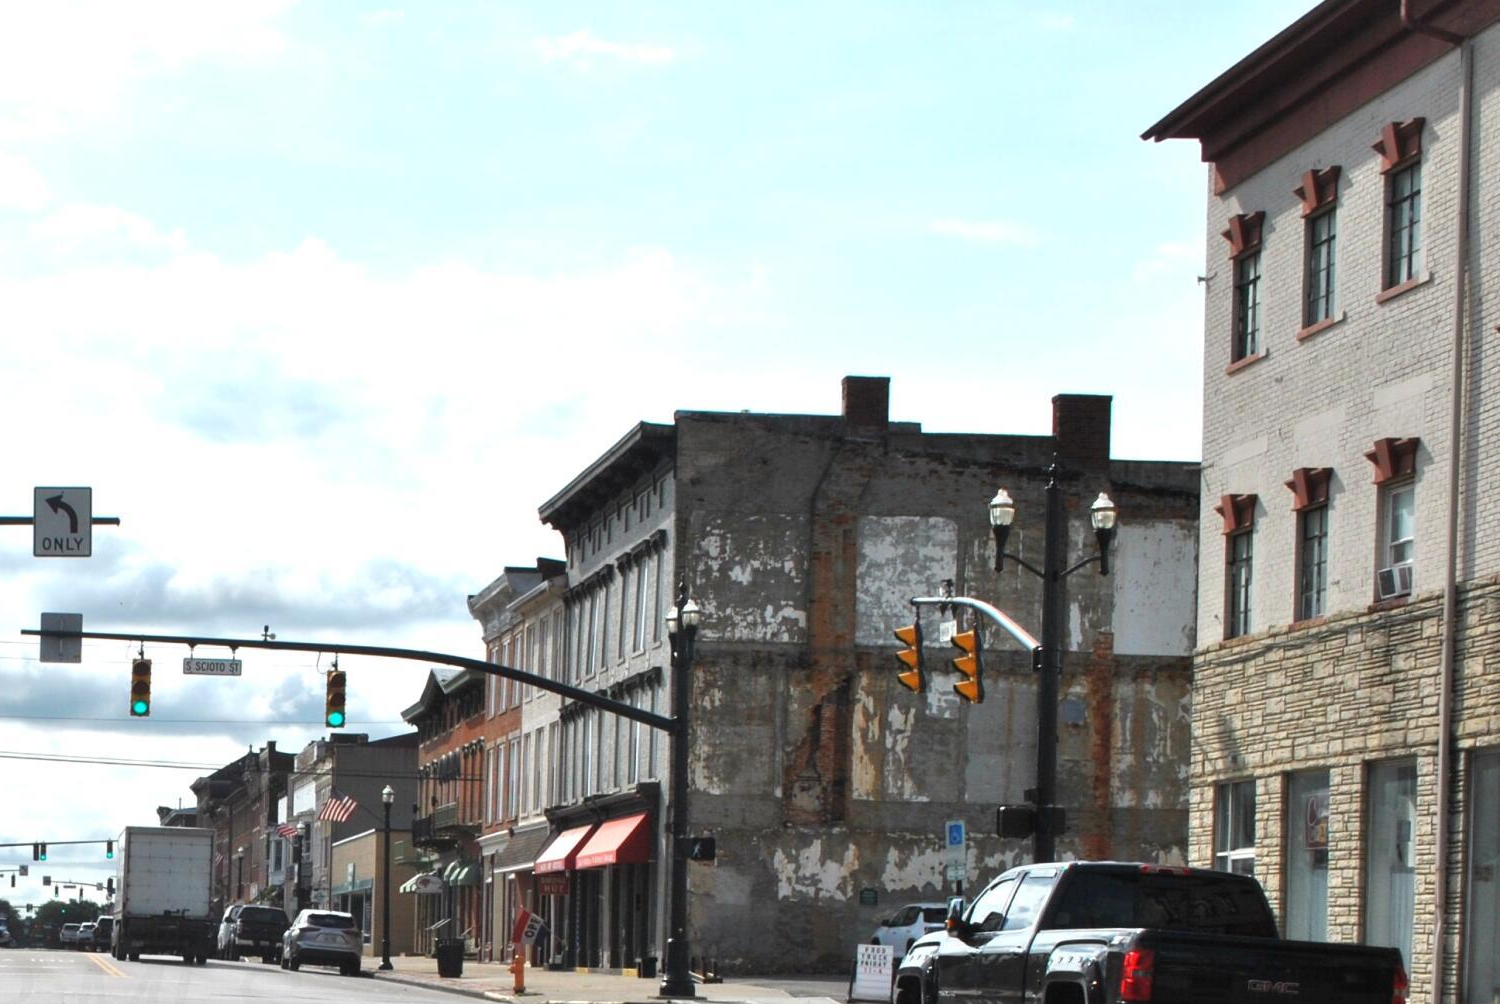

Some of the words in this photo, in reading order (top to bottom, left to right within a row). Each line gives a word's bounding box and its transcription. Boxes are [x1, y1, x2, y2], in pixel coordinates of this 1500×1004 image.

[42, 537, 83, 551] ONLY
[186, 661, 192, 671] S
[195, 661, 226, 672] SCIOTO
[229, 663, 239, 673] ST
[524, 915, 541, 938] OPE
[860, 960, 887, 968] FRIDAY
[1247, 979, 1300, 994] GMC
